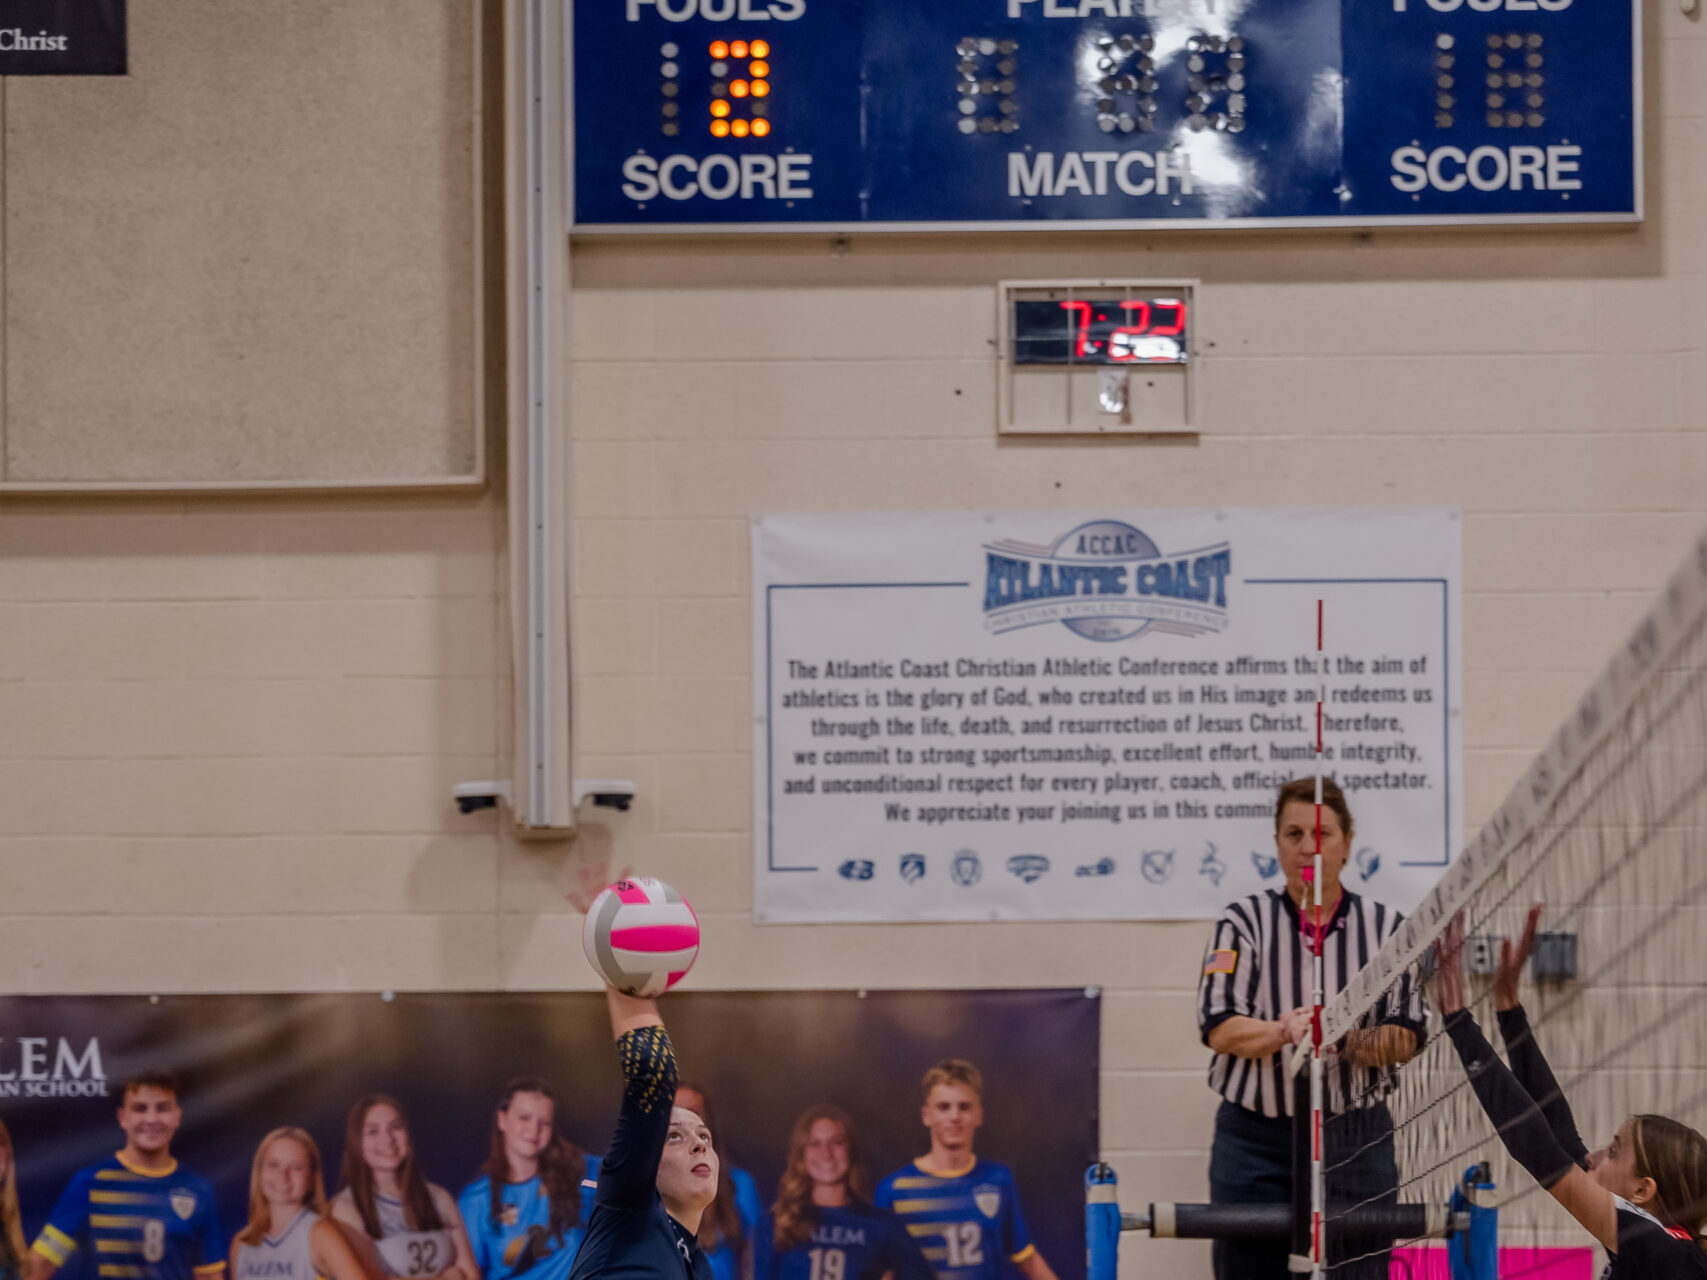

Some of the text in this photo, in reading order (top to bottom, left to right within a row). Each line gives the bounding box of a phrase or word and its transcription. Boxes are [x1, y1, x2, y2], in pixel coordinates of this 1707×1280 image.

[0, 28, 68, 51] Christ
[709, 39, 770, 138] 2
[622, 154, 813, 201] SCORE
[1007, 151, 1194, 197] MATCH
[1390, 145, 1582, 192] SCORE
[1076, 534, 1138, 555] ACCAC
[983, 548, 1231, 612] ATLANTIC COAST
[788, 659, 818, 679] The
[824, 659, 894, 679] Atlantic
[900, 658, 949, 678] Coast
[956, 658, 1036, 677] Christian
[1043, 657, 1112, 677] Athletic
[1118, 657, 1218, 676] Conference
[1225, 656, 1287, 675] affirms
[1337, 655, 1364, 674] the
[1371, 655, 1403, 674] aim
[1409, 655, 1427, 674] of
[782, 689, 859, 708] athletics
[865, 689, 879, 708] is
[886, 688, 913, 707] the
[920, 687, 964, 711] glory
[970, 687, 987, 706] of
[993, 687, 1032, 707] God,
[1039, 687, 1072, 705] who
[1079, 686, 1146, 705] created
[1152, 689, 1172, 704] us
[1178, 686, 1194, 704] in
[1201, 685, 1228, 704] His
[1234, 685, 1286, 707] image
[1332, 684, 1407, 703] redeems
[1413, 688, 1432, 703] us
[811, 717, 880, 740] through
[887, 716, 914, 736] the
[921, 716, 954, 737] life,
[960, 715, 1014, 737] death,
[1021, 714, 1052, 734] and
[1059, 714, 1167, 734] resurrection
[1174, 714, 1191, 733] of
[1197, 713, 1243, 733] Jesus
[1249, 713, 1308, 732] Christ.
[794, 750, 817, 765] we
[824, 746, 889, 765] commit
[896, 747, 914, 765] to
[920, 746, 975, 767] strong
[982, 744, 1117, 767] sportsmanship,
[1123, 743, 1202, 761] excellent
[1209, 743, 1263, 763] effort,
[1341, 741, 1422, 764] integrity,
[784, 774, 815, 794] and
[822, 774, 941, 793] unconditional
[948, 774, 1013, 796] respect
[1020, 774, 1044, 792] for
[1051, 776, 1097, 794] every
[1104, 772, 1163, 795] player,
[1170, 771, 1226, 791] coach,
[1343, 772, 1432, 793] spectator.
[885, 803, 910, 822] We
[917, 803, 1010, 825] appreciate
[1017, 805, 1054, 824] your
[1061, 802, 1121, 824] joining
[1128, 805, 1147, 820] us
[1153, 802, 1169, 819] in
[1176, 800, 1208, 819] this
[24, 1080, 110, 1097] SCHOOL
[143, 1218, 165, 1263] 8
[943, 1221, 983, 1267] 12
[408, 1238, 438, 1276] 32
